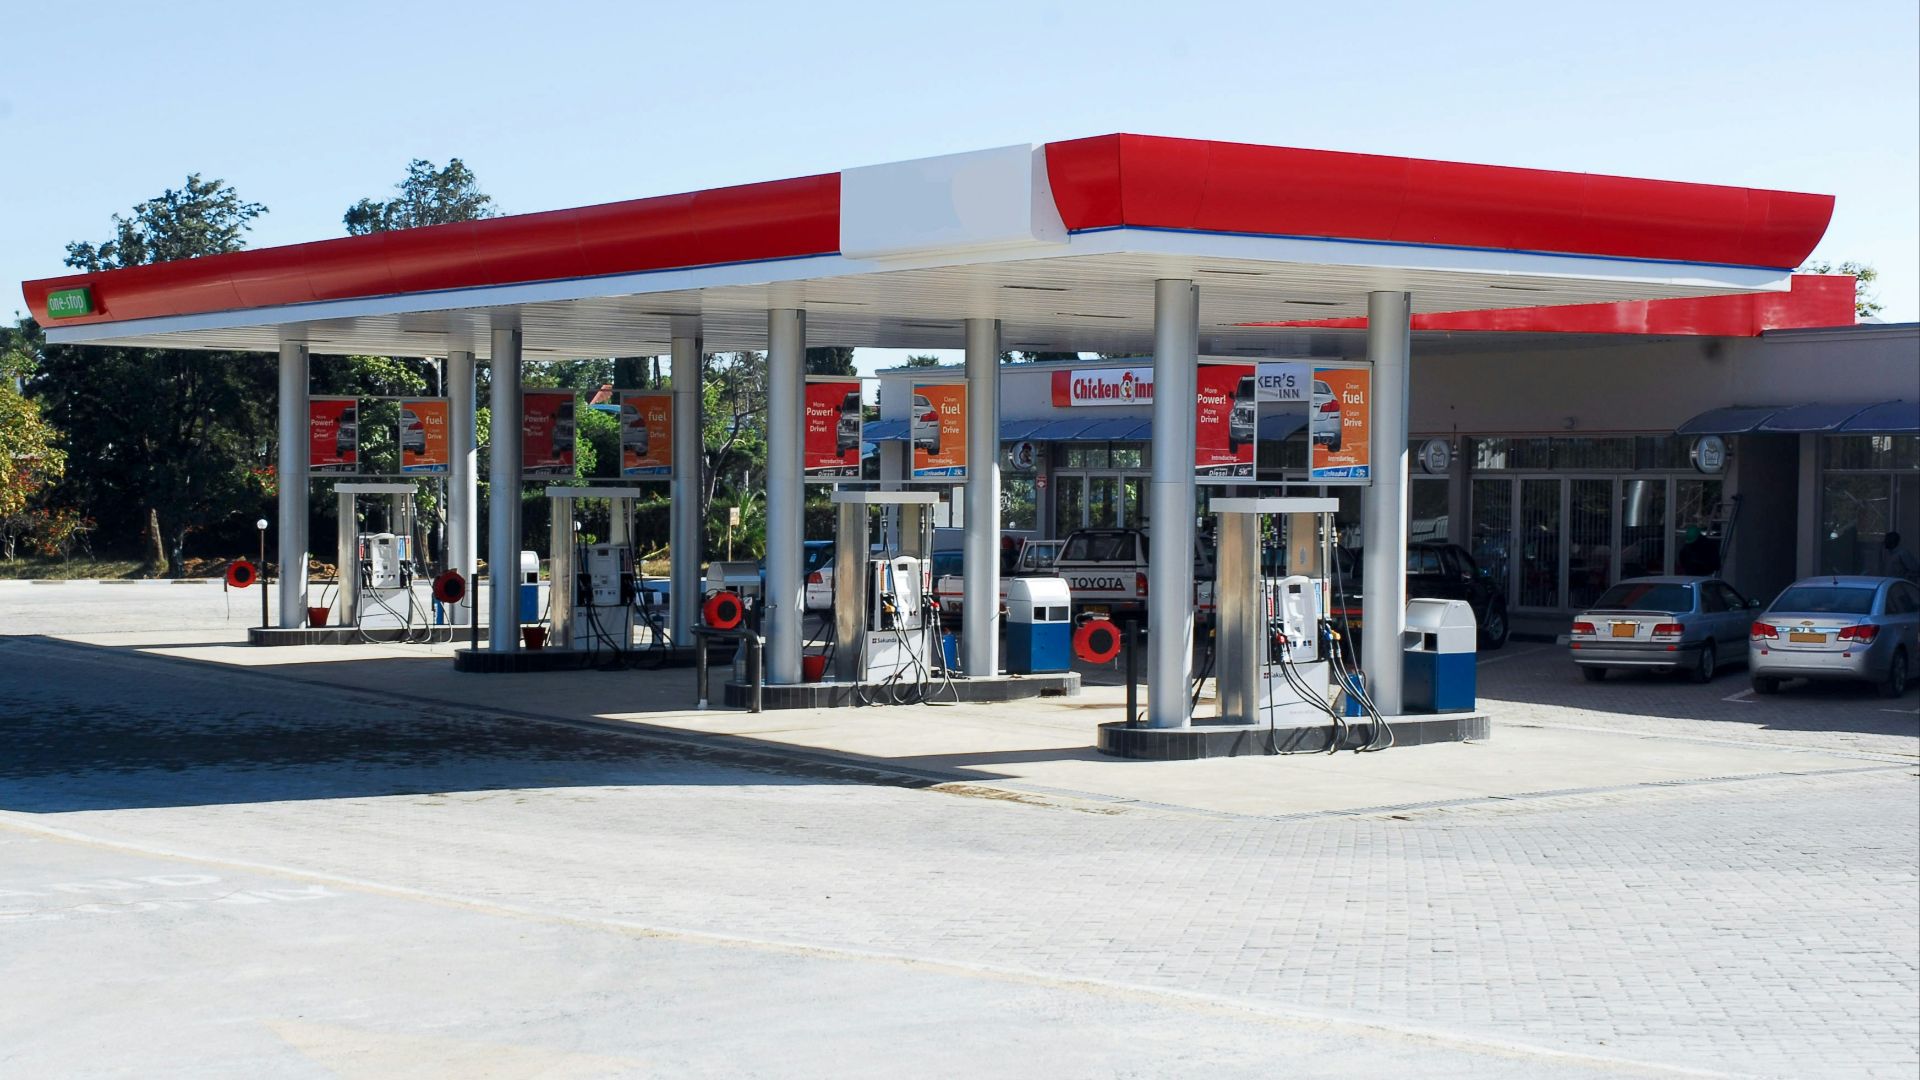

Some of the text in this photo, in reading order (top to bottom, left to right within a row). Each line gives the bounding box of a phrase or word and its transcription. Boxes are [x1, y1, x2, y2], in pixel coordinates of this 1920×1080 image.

[49, 294, 83, 313] one-stop
[1073, 377, 1153, 399] Chicken inn
[1345, 382, 1360, 390] Clean
[1197, 393, 1226, 405] Power!
[1278, 388, 1300, 399] INN
[1342, 390, 1364, 404] fuel
[806, 407, 834, 417] Power!
[940, 402, 961, 415] fuel
[425, 415, 443, 425] fuel
[648, 411, 667, 422] fuel
[1200, 415, 1219, 424] Drive!
[1343, 417, 1363, 427] Drive
[809, 425, 828, 433] Drive!
[942, 426, 960, 435] Drive
[1070, 577, 1125, 589] TOYOTA
